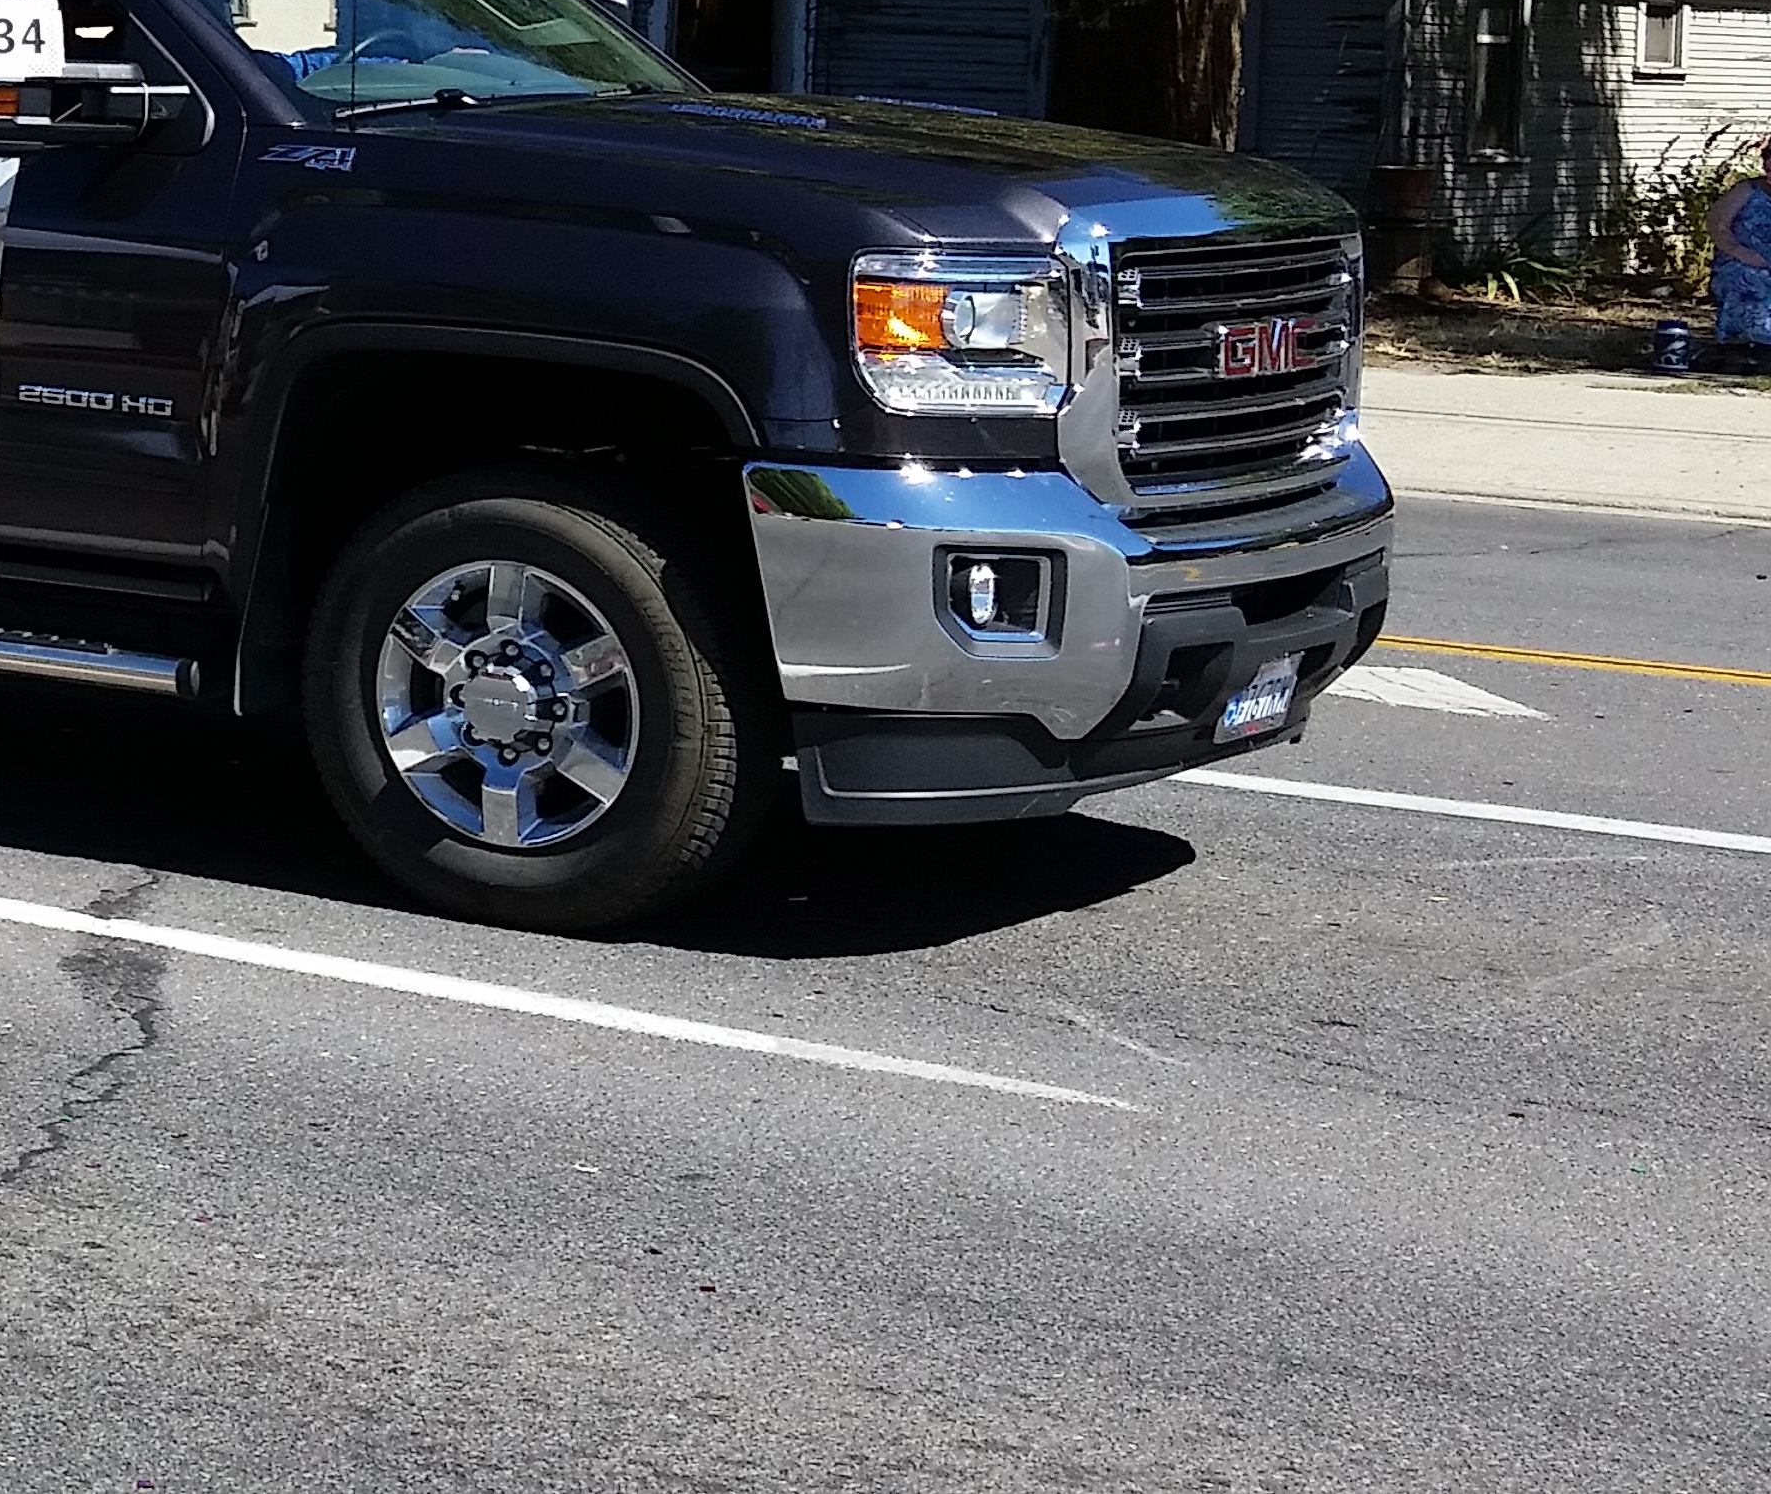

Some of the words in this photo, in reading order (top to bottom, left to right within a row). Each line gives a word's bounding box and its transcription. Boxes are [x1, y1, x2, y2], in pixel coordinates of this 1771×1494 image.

[1219, 317, 1317, 378] GMC
[18, 384, 114, 411] 2500
[121, 394, 174, 417] HD
